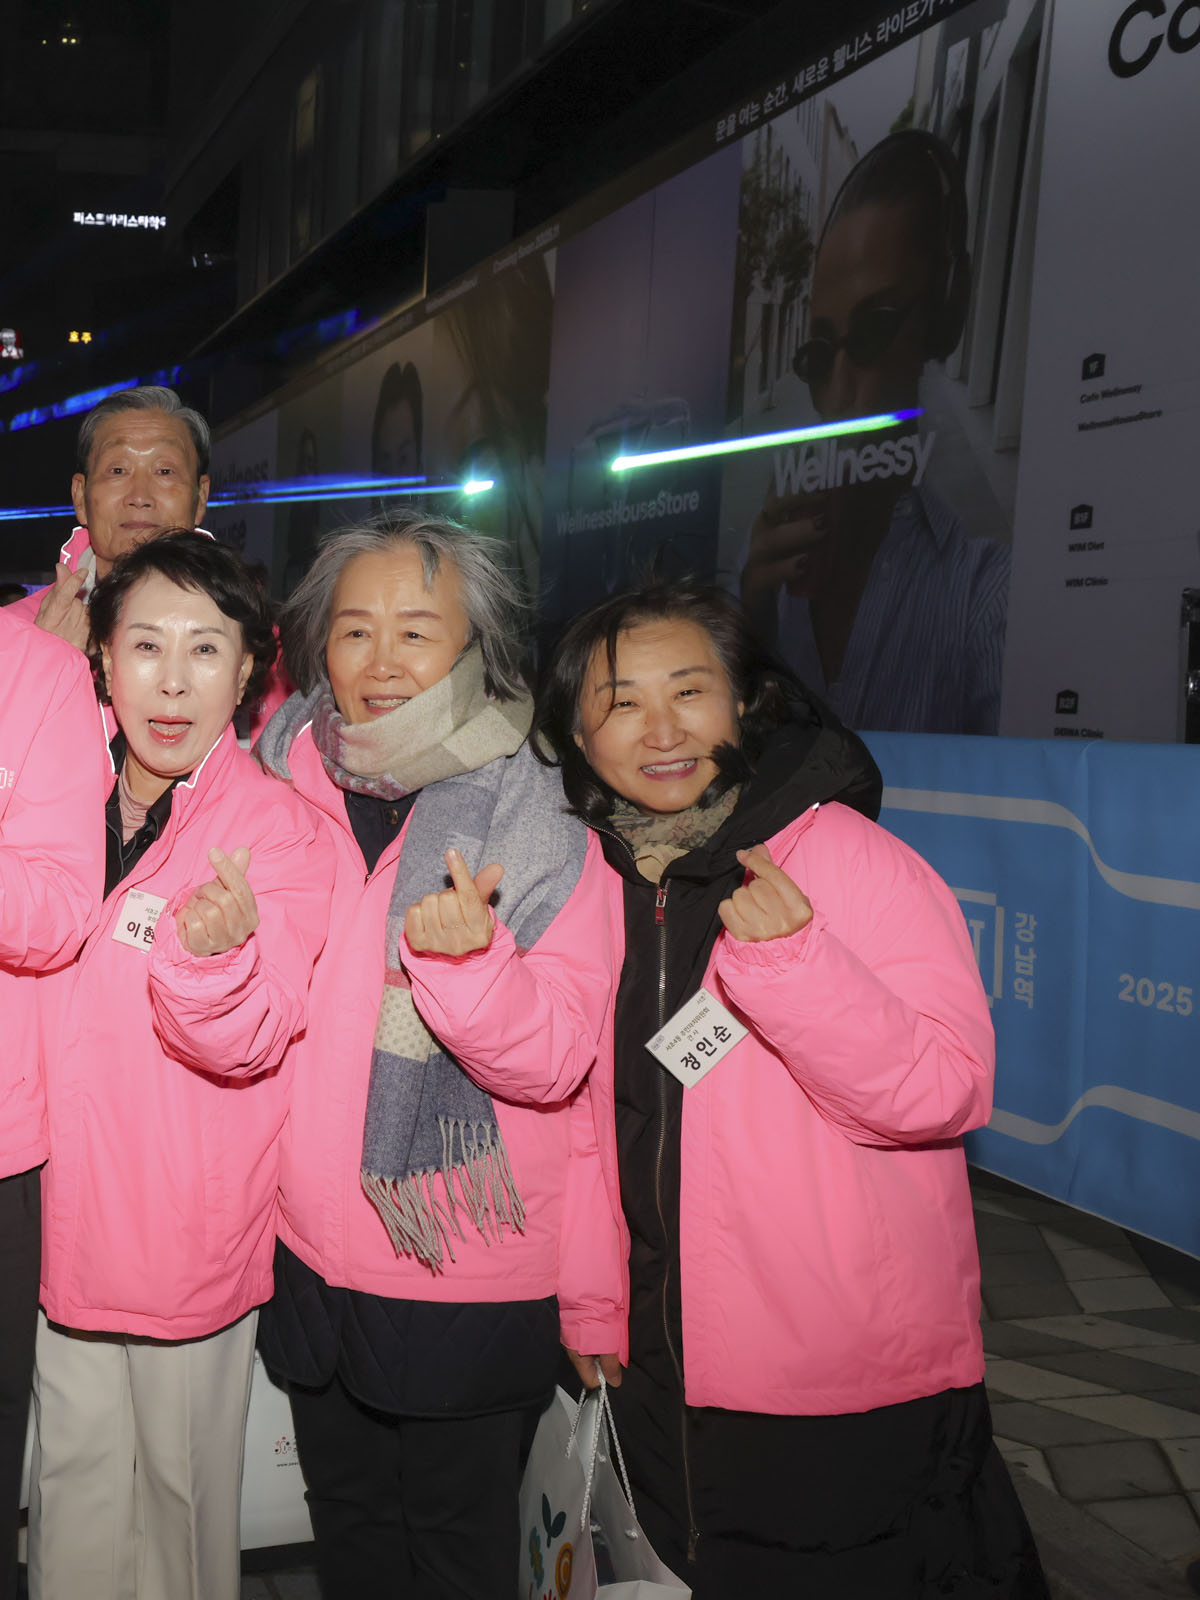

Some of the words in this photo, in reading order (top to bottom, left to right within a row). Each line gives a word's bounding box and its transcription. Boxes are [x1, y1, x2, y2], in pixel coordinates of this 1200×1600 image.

[739, 101, 760, 126] 여는
[792, 57, 830, 93] 새로운
[774, 431, 937, 497] Wellnessy
[1117, 972, 1193, 1017] 2025
[680, 1025, 732, 1071] 정인순
